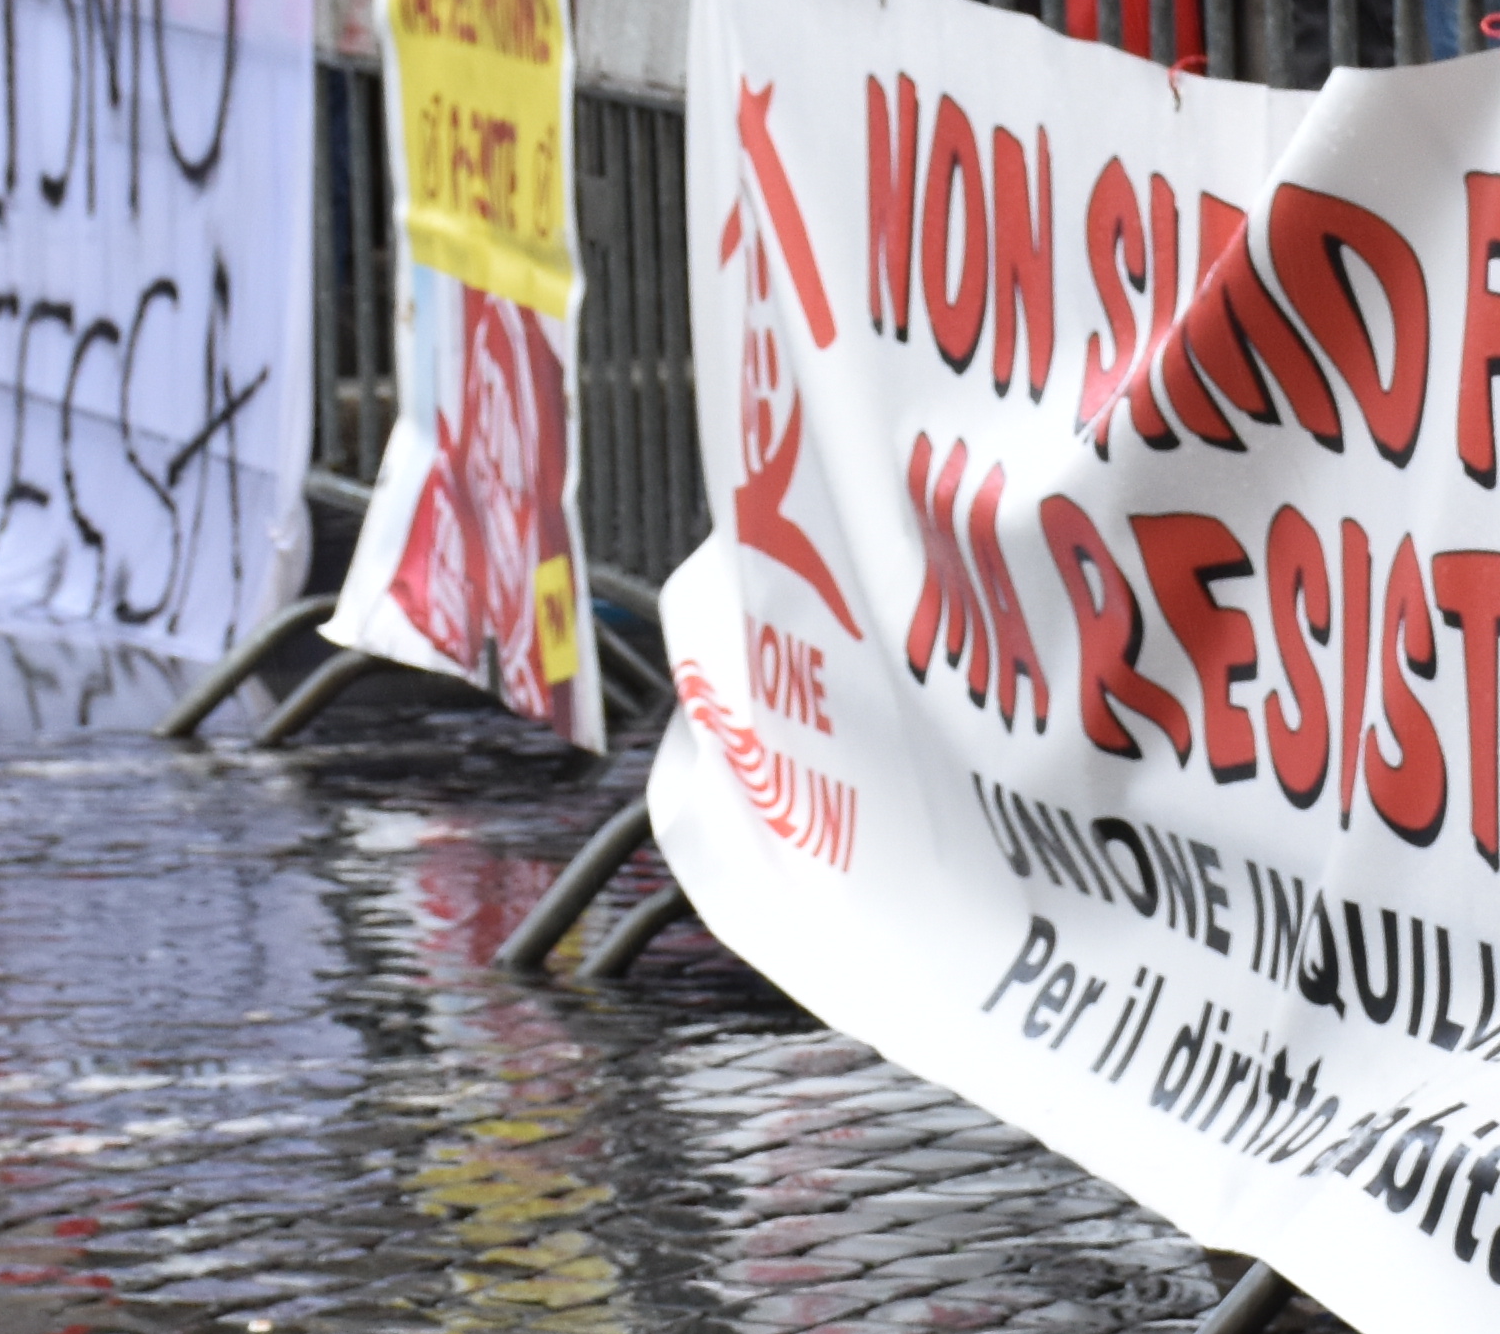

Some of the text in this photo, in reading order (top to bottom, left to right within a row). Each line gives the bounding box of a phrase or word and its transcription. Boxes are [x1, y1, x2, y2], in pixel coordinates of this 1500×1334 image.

[867, 72, 1053, 405] NON
[906, 429, 1050, 735] MA
[971, 772, 1232, 957] UNIONE
[980, 914, 1108, 1050] Per
[1090, 965, 1165, 1083] il
[1149, 1000, 1339, 1164] diritto
